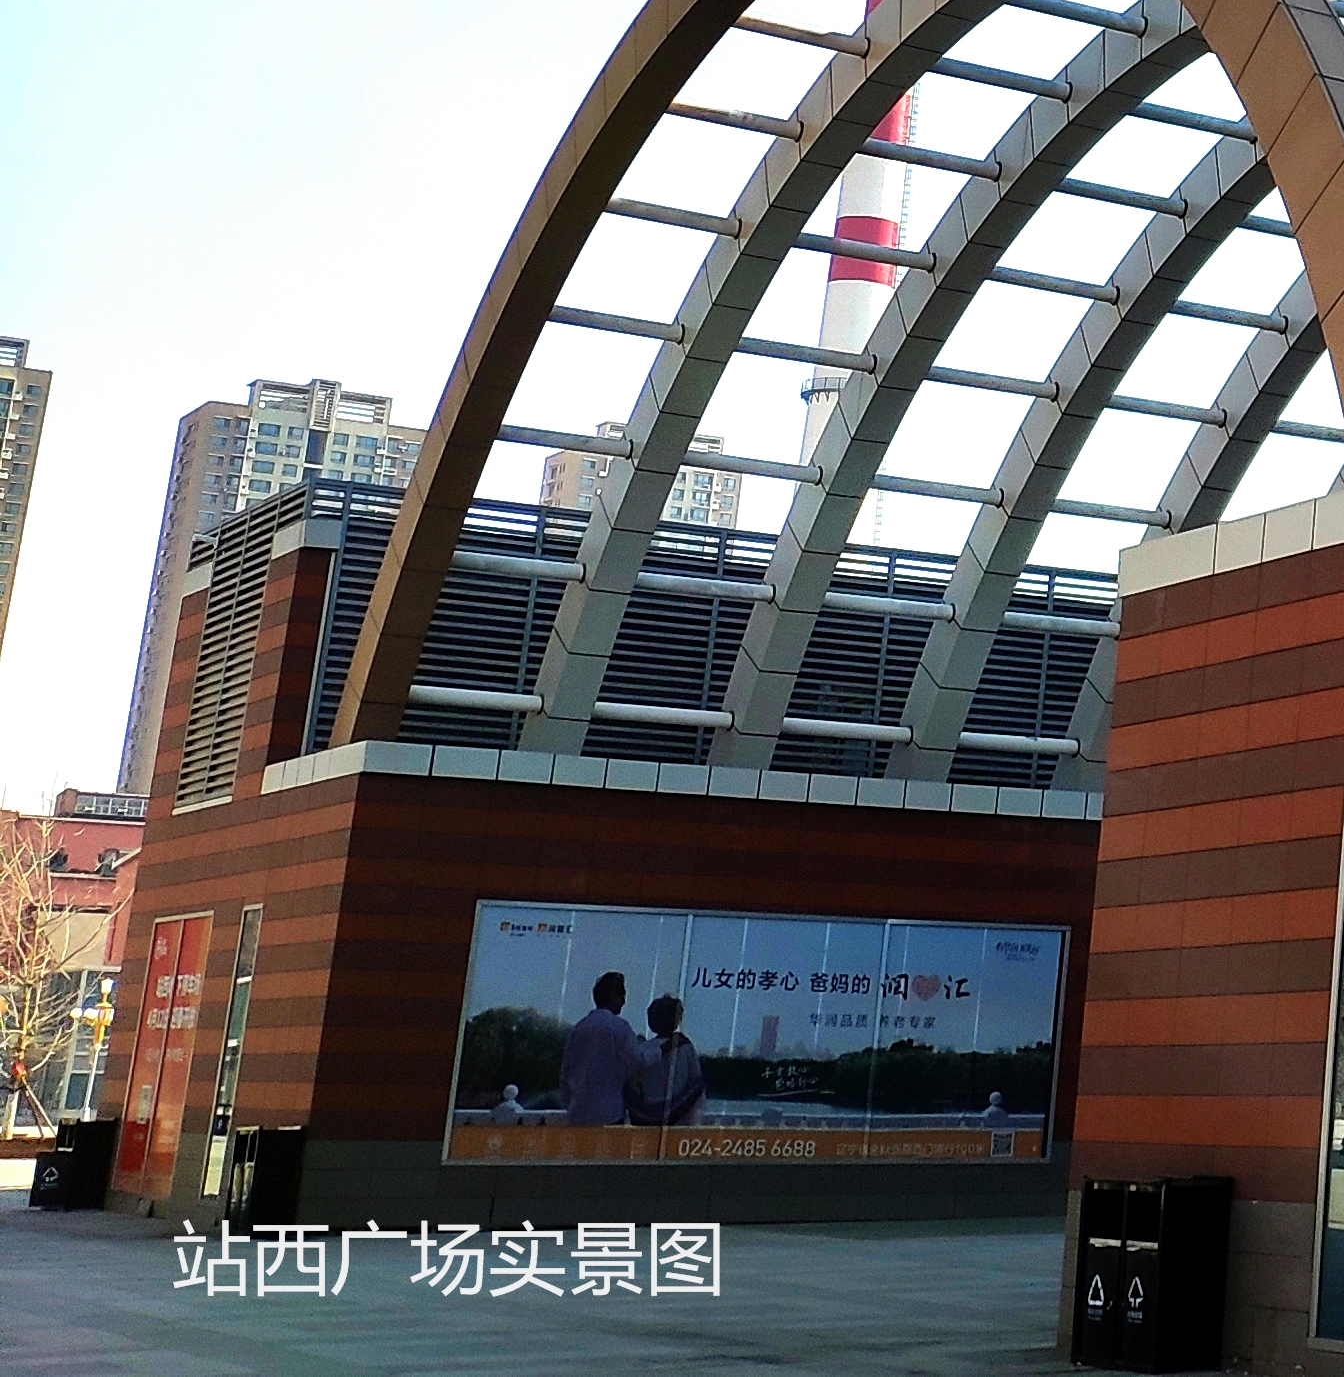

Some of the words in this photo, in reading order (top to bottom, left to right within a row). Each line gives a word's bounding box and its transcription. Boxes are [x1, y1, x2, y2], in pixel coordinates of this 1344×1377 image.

[692, 968, 800, 991] 儿女的孝心
[809, 973, 871, 995] 爸妈的
[771, 1140, 816, 1157] 6688
